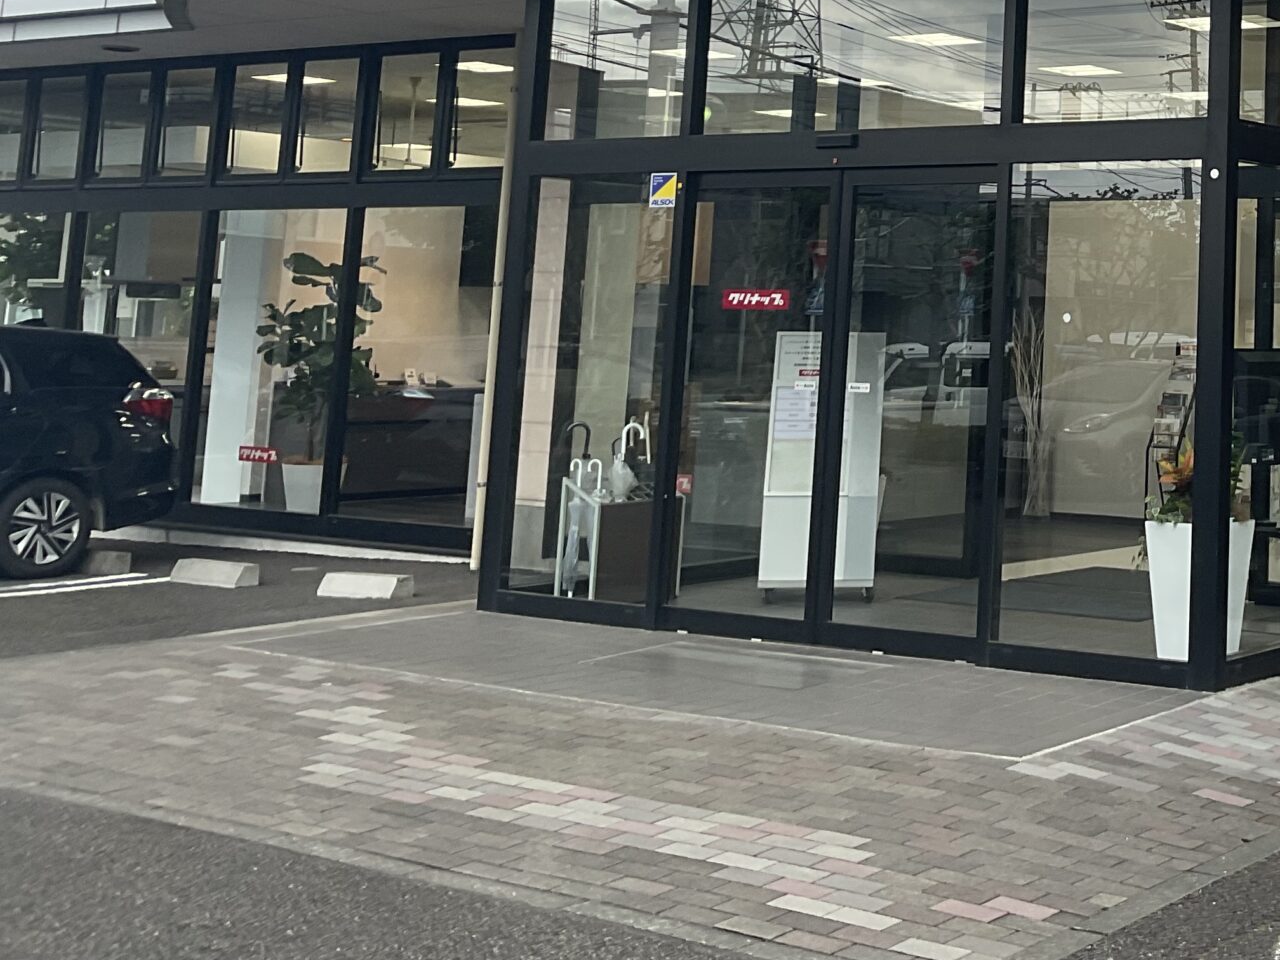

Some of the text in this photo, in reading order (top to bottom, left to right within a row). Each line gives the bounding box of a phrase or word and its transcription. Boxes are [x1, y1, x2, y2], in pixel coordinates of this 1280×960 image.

[728, 292, 784, 306] クリナップ
